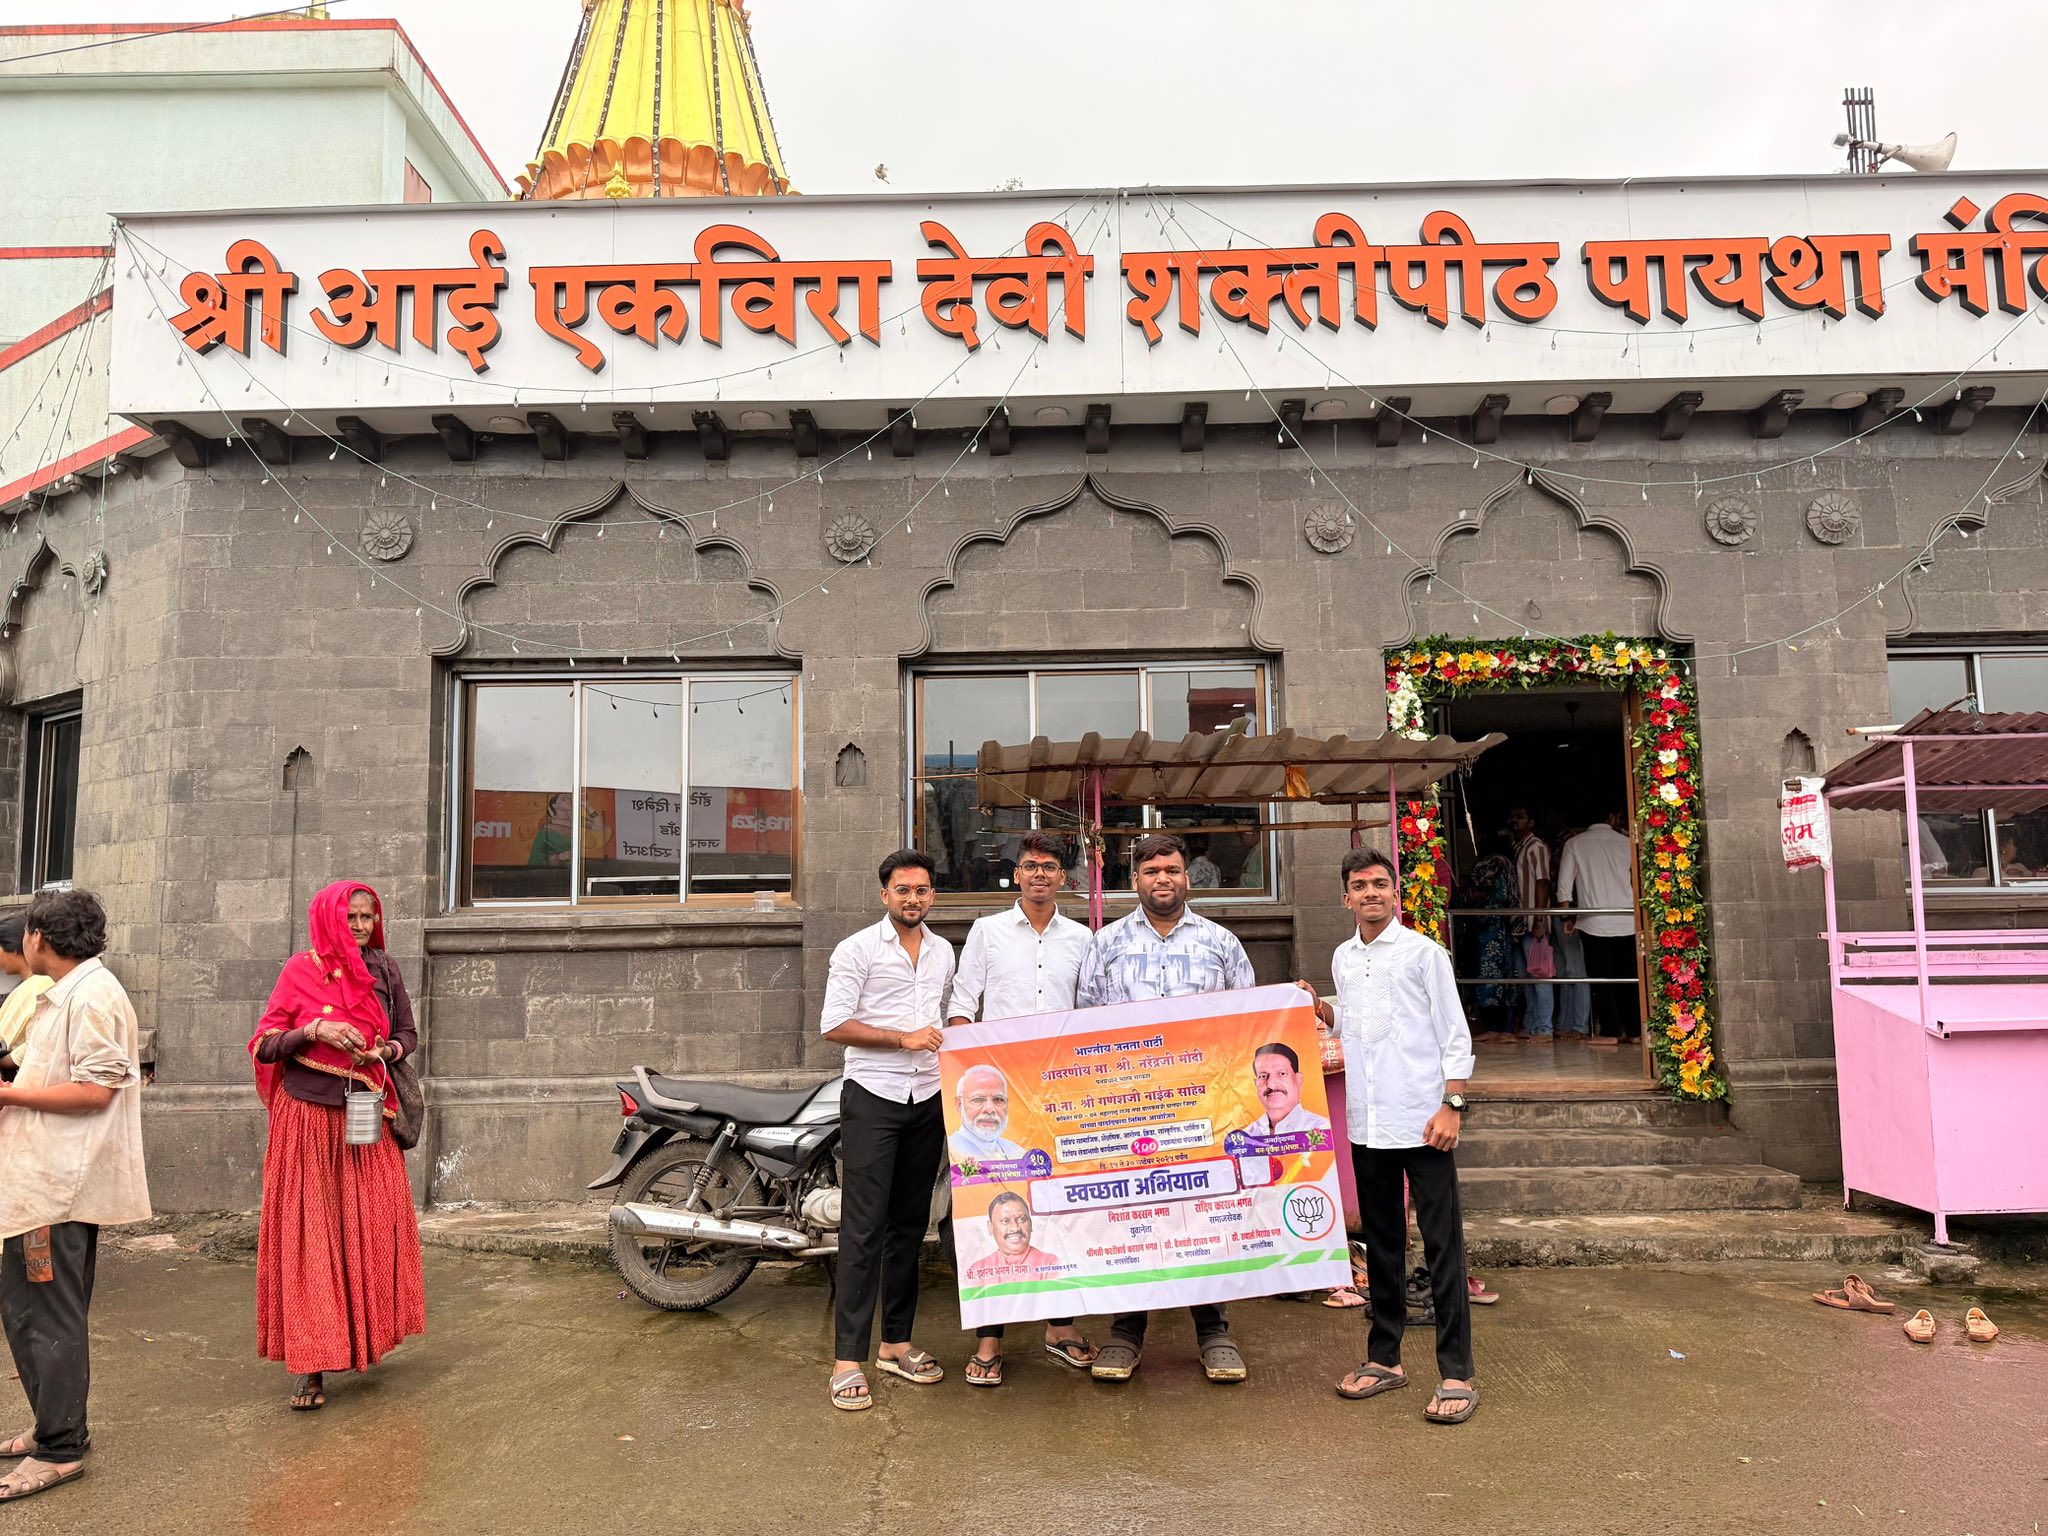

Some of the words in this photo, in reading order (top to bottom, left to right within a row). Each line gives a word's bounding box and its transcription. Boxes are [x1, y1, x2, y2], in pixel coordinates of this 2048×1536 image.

[169, 238, 297, 357] श्री
[309, 229, 509, 373] आई
[529, 223, 892, 373] एकविरा
[916, 221, 1094, 351] देवी
[1121, 211, 1559, 347] शक्तीपीठ
[1582, 233, 1892, 324] पायथा
[1908, 193, 2048, 318] मं
[1075, 1043, 1111, 1056] भारतीय
[1114, 1041, 1140, 1053] जनता
[1143, 1035, 1163, 1048] पार्टी
[1041, 1063, 1091, 1081] आदरणीय
[1095, 1063, 1112, 1074] मा.
[1116, 1057, 1135, 1071] श्री.
[1139, 1053, 1175, 1069] नरेंद्रजी
[1178, 1048, 1203, 1063] मोदी
[1081, 1094, 1095, 1109] श्री
[1098, 1089, 1141, 1106] गणेशजी
[1144, 1085, 1174, 1102] नाईक
[1177, 1083, 1206, 1098] साहेब
[1230, 1133, 1245, 1146] १५
[1133, 1141, 1157, 1154] १००
[1030, 1154, 1045, 1166] १७
[1064, 1178, 1129, 1203] स्वच्छता
[1134, 1169, 1209, 1196] अभियान
[1237, 1197, 1253, 1208] भगत
[1108, 1208, 1130, 1223] निशांत
[1154, 1206, 1170, 1218] भगत
[1209, 1212, 1242, 1224] समाजसेवक
[1129, 1224, 1152, 1238] युवानेता
[25, 1258, 52, 1268] 2025
